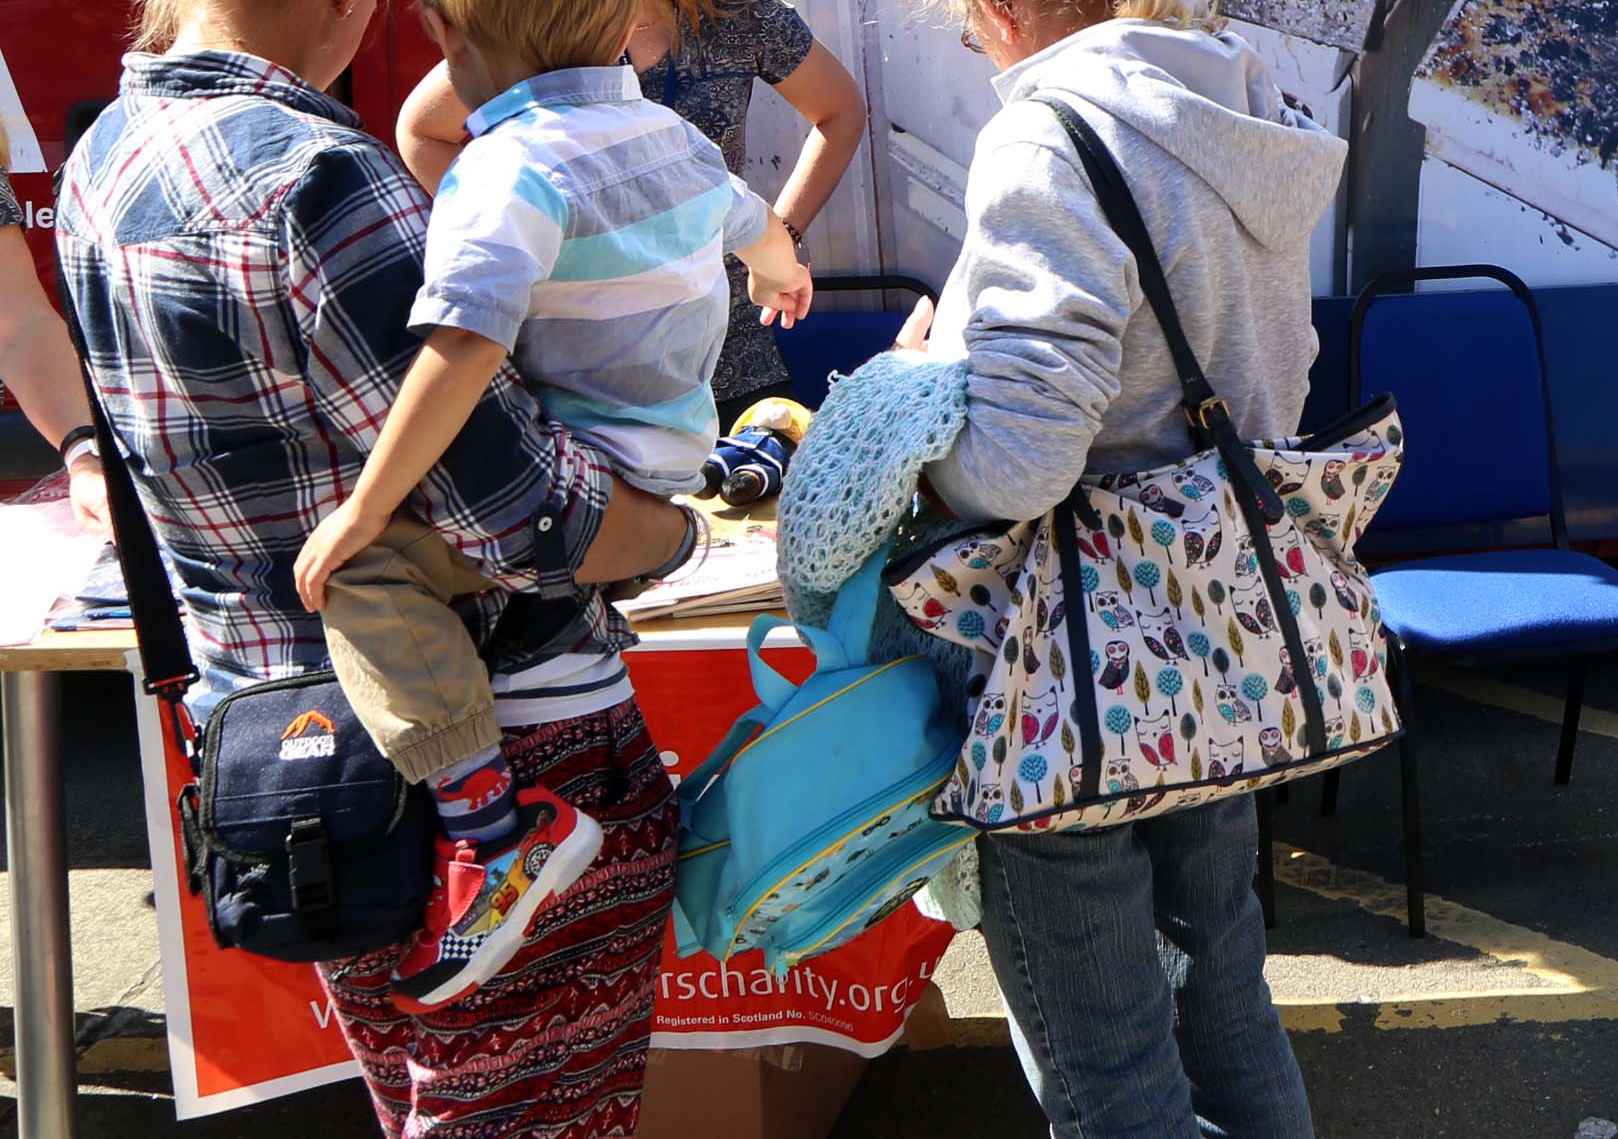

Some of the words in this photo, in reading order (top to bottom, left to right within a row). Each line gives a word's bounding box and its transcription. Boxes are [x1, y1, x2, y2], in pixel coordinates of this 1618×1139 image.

[281, 735, 335, 751] OUTDOOR
[279, 744, 335, 760] GEAR
[490, 881, 519, 916] 95
[656, 1016, 715, 1026] Registered
[719, 1015, 729, 1024] in
[732, 1010, 783, 1024] Scotland
[786, 1010, 806, 1020] No.
